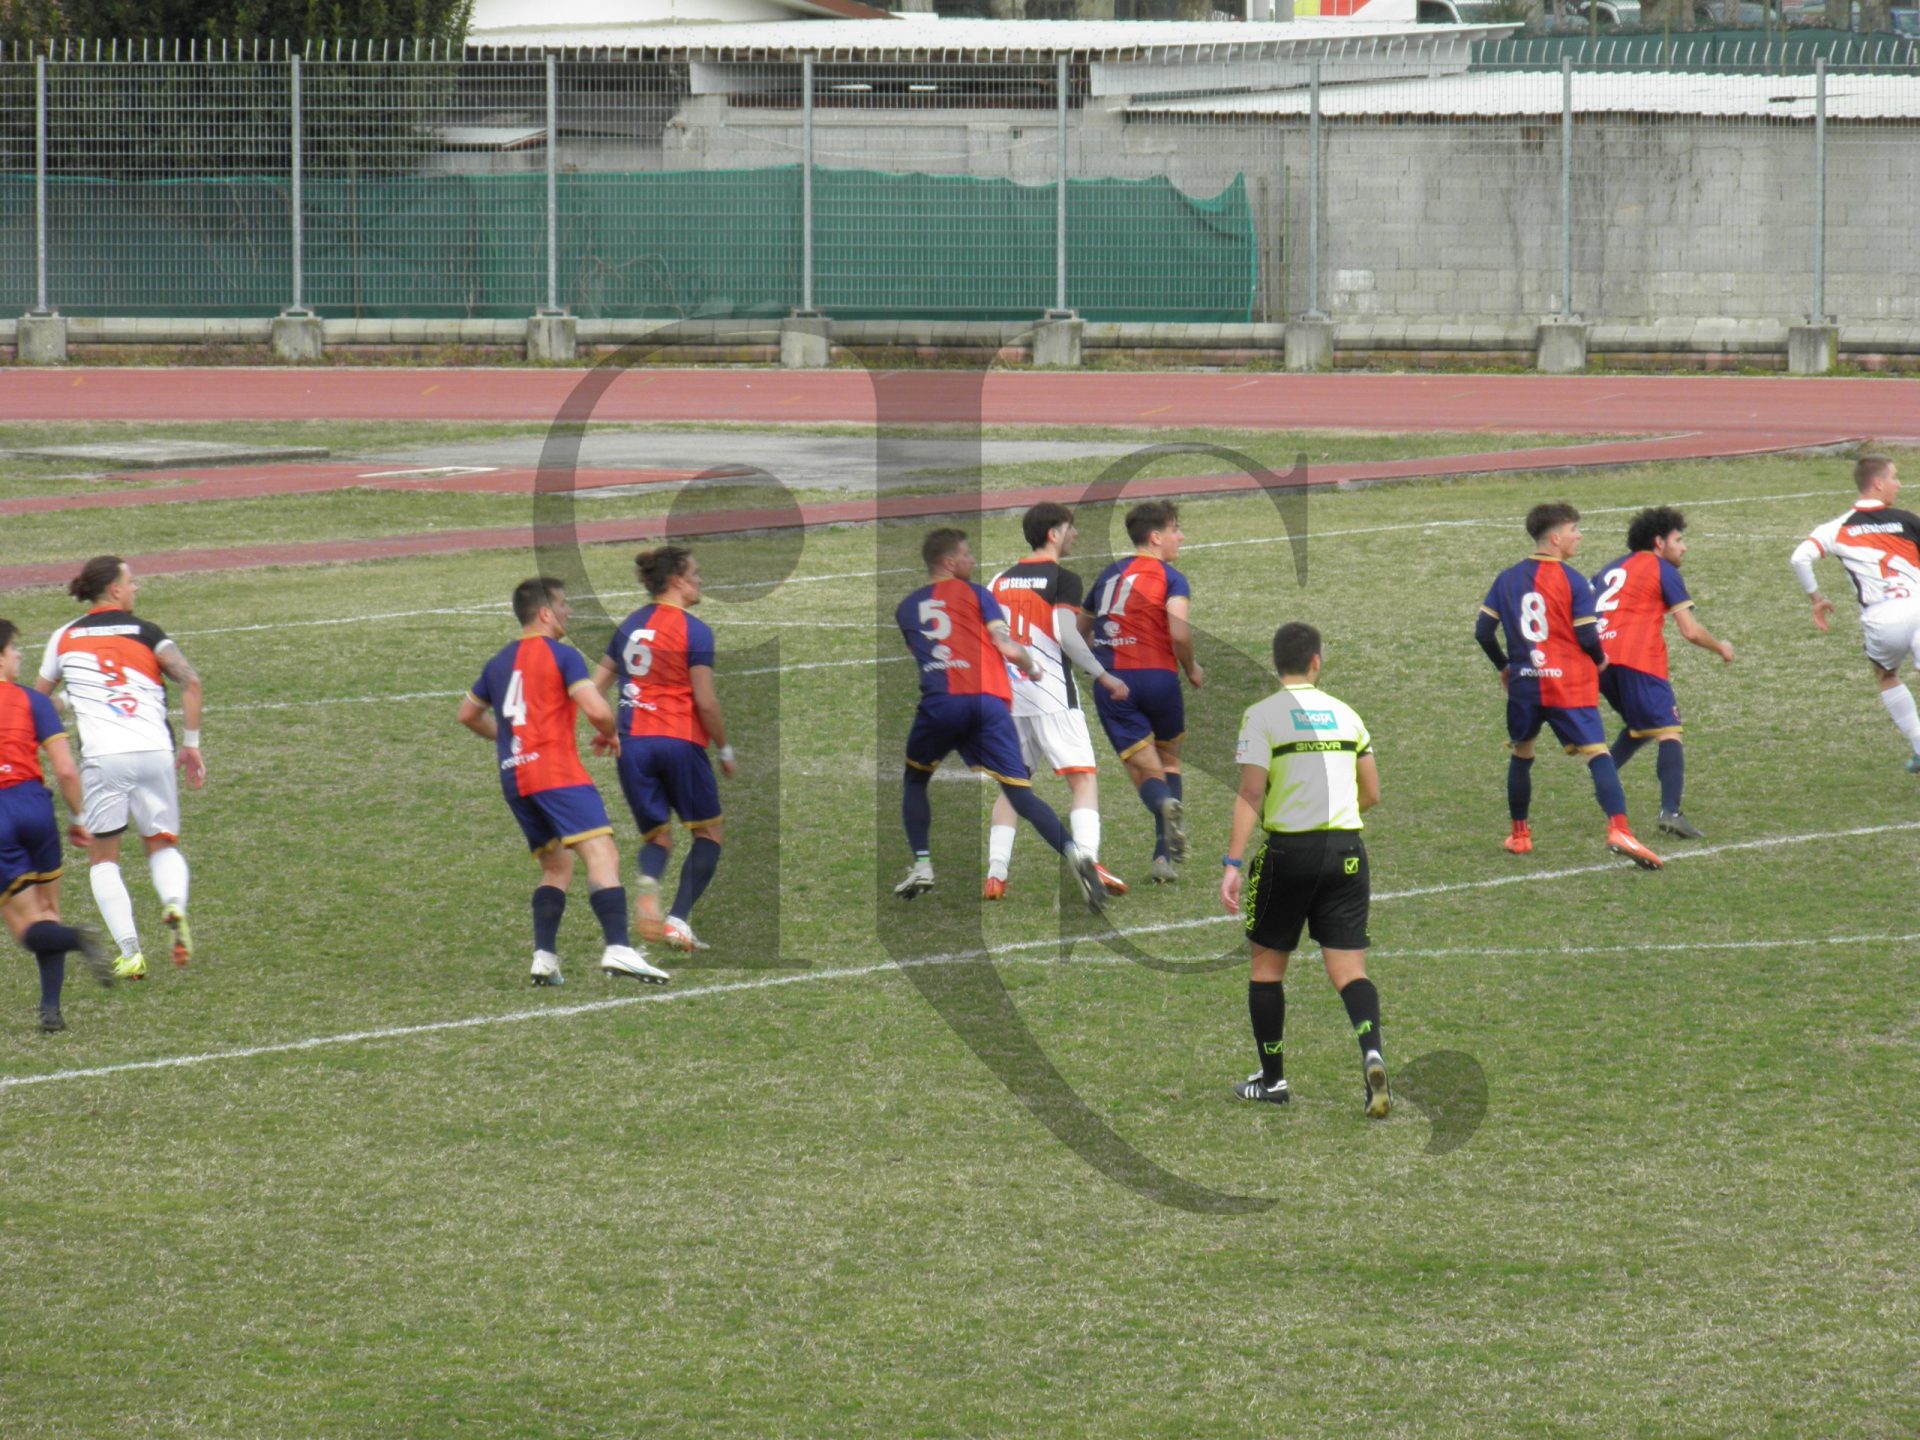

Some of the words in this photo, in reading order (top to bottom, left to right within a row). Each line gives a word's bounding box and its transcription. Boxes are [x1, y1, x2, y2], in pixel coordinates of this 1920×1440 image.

[1096, 573, 1139, 617] 11
[1596, 568, 1627, 612] 2
[918, 599, 953, 641] 5
[1520, 592, 1548, 642] 8
[623, 628, 656, 676] 6
[502, 670, 527, 726] 4
[1295, 741, 1342, 752] GIVOVA
